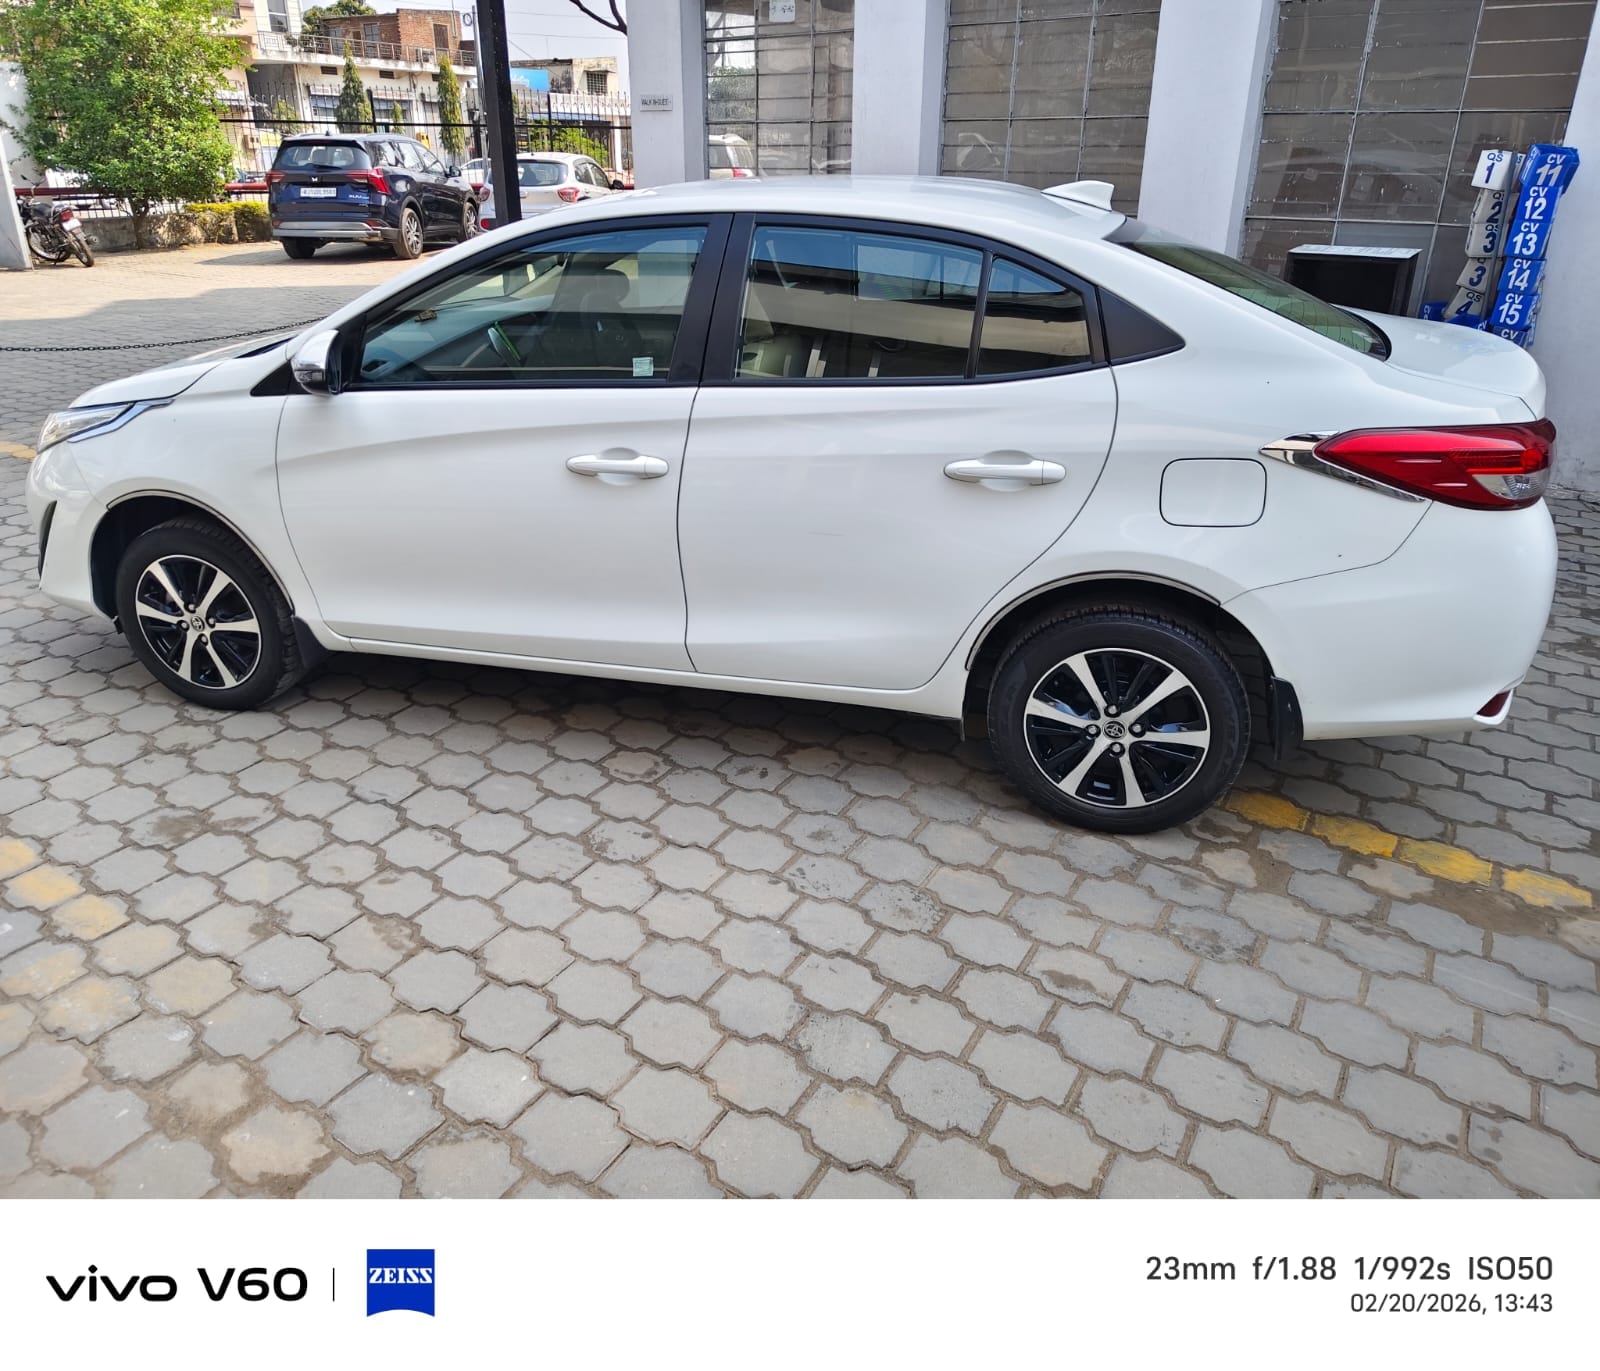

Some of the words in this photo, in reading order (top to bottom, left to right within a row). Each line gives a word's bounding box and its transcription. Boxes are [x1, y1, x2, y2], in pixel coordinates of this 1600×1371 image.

[1487, 152, 1504, 163] QS
[1547, 153, 1566, 164] CV
[1485, 162, 1495, 184] 1
[1536, 164, 1562, 187] 11
[1530, 186, 1548, 197] CV
[1486, 201, 1503, 223] 2
[1525, 197, 1547, 219] 12
[1521, 222, 1540, 233] CV
[1483, 232, 1497, 253] 3
[1513, 232, 1538, 256] 13
[1513, 258, 1531, 270] CV
[1469, 265, 1487, 287] 3
[1507, 268, 1531, 291] 14
[1466, 291, 1482, 302] QS
[1505, 293, 1524, 304] CV
[1455, 301, 1473, 315] 4
[1498, 302, 1523, 325] 15
[1501, 328, 1518, 340] CV
